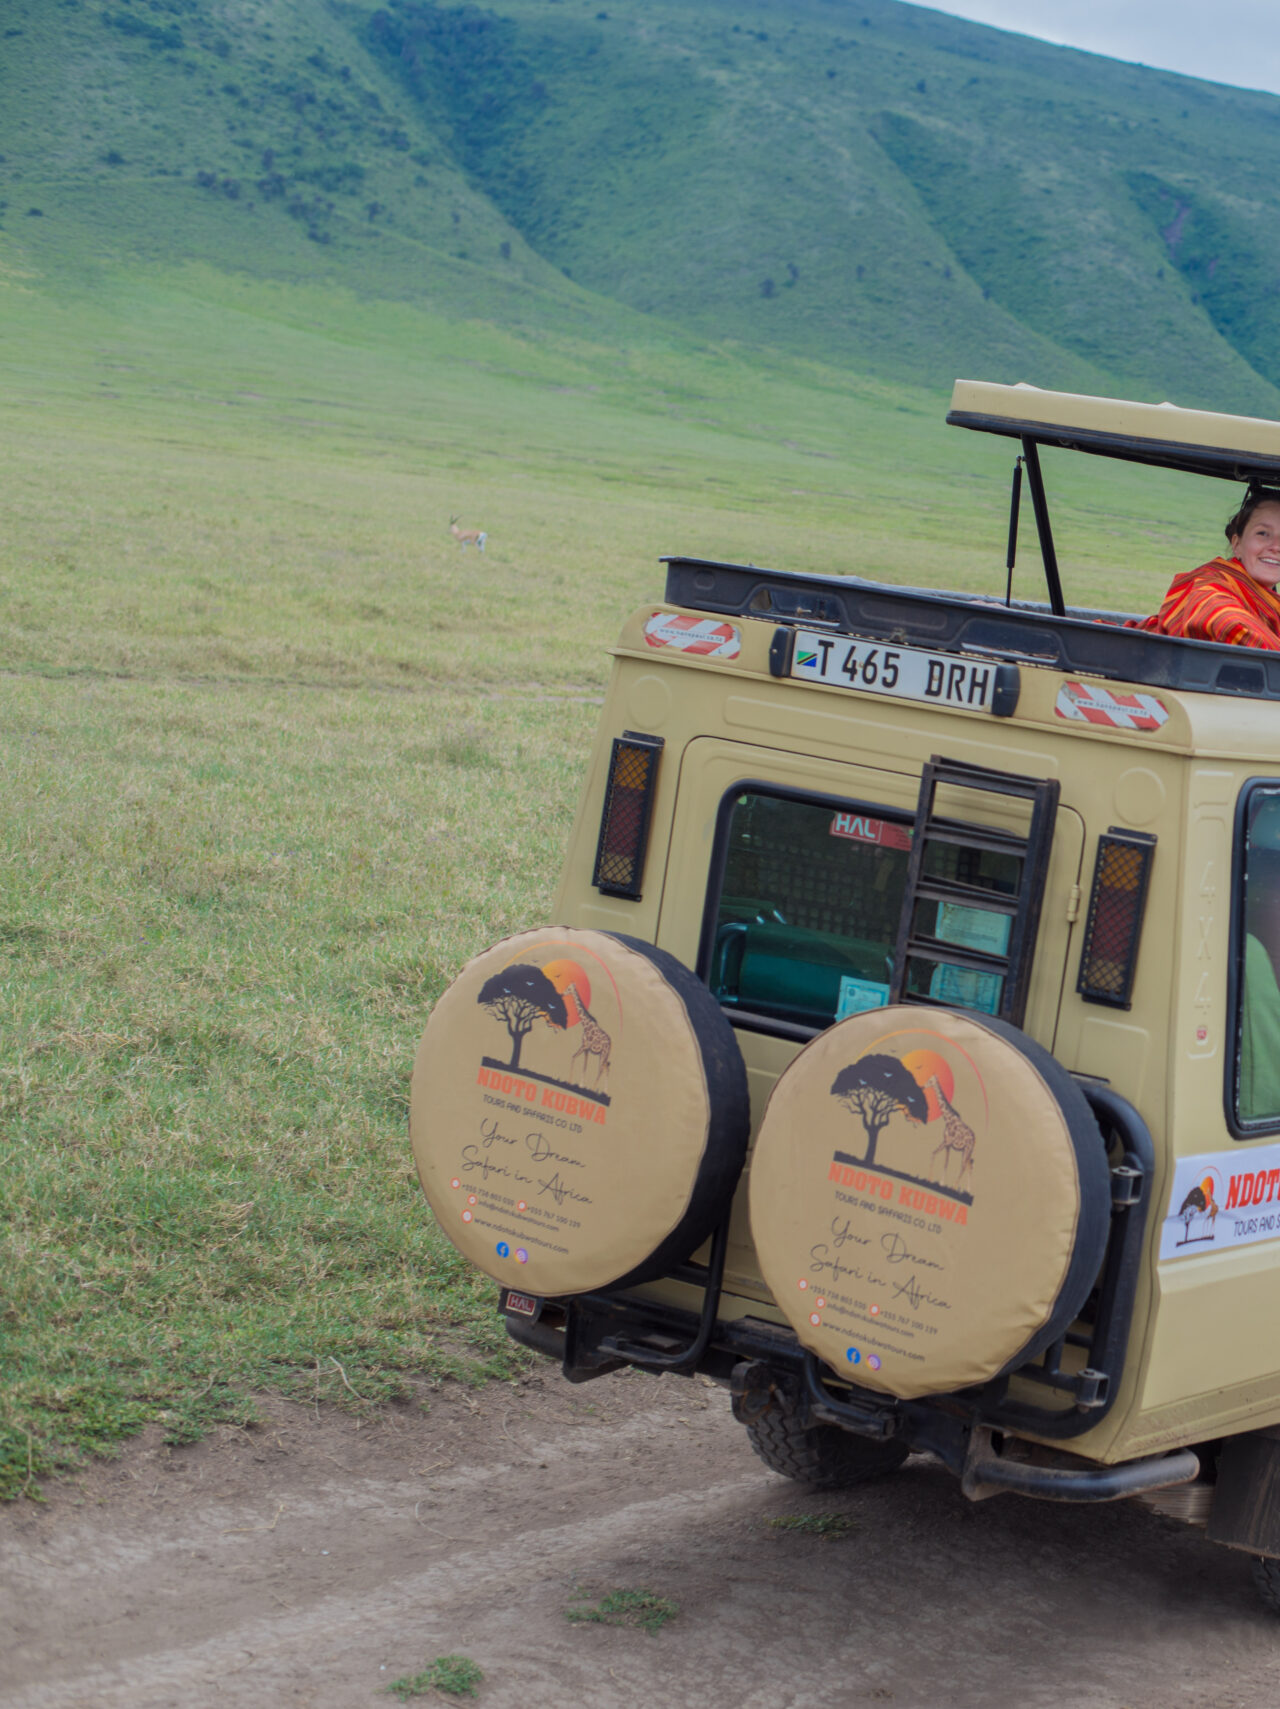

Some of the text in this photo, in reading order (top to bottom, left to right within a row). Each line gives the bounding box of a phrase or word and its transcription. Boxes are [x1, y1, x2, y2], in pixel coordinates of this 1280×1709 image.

[818, 639, 990, 707] T 465 DRH
[835, 812, 876, 839] HAL
[476, 1066, 607, 1126] NDOTO KUBWA
[483, 1094, 506, 1109] TOURS
[506, 1102, 521, 1114] AND
[522, 1107, 554, 1125] SAFARIS
[569, 1122, 584, 1134] LTD
[480, 1117, 587, 1169] Your Dream
[461, 1144, 593, 1206] Safari in Africa
[827, 1161, 969, 1227] NDOTO KUBWA
[834, 1189, 859, 1207] TOURS
[859, 1199, 876, 1213] AND
[877, 1204, 912, 1225] SAFARIS
[927, 1222, 943, 1235] LTD
[1233, 1217, 1259, 1237] TOURS
[1259, 1214, 1276, 1232] AND
[830, 1215, 945, 1272] Your Dream
[809, 1243, 953, 1310] Safari in Africa
